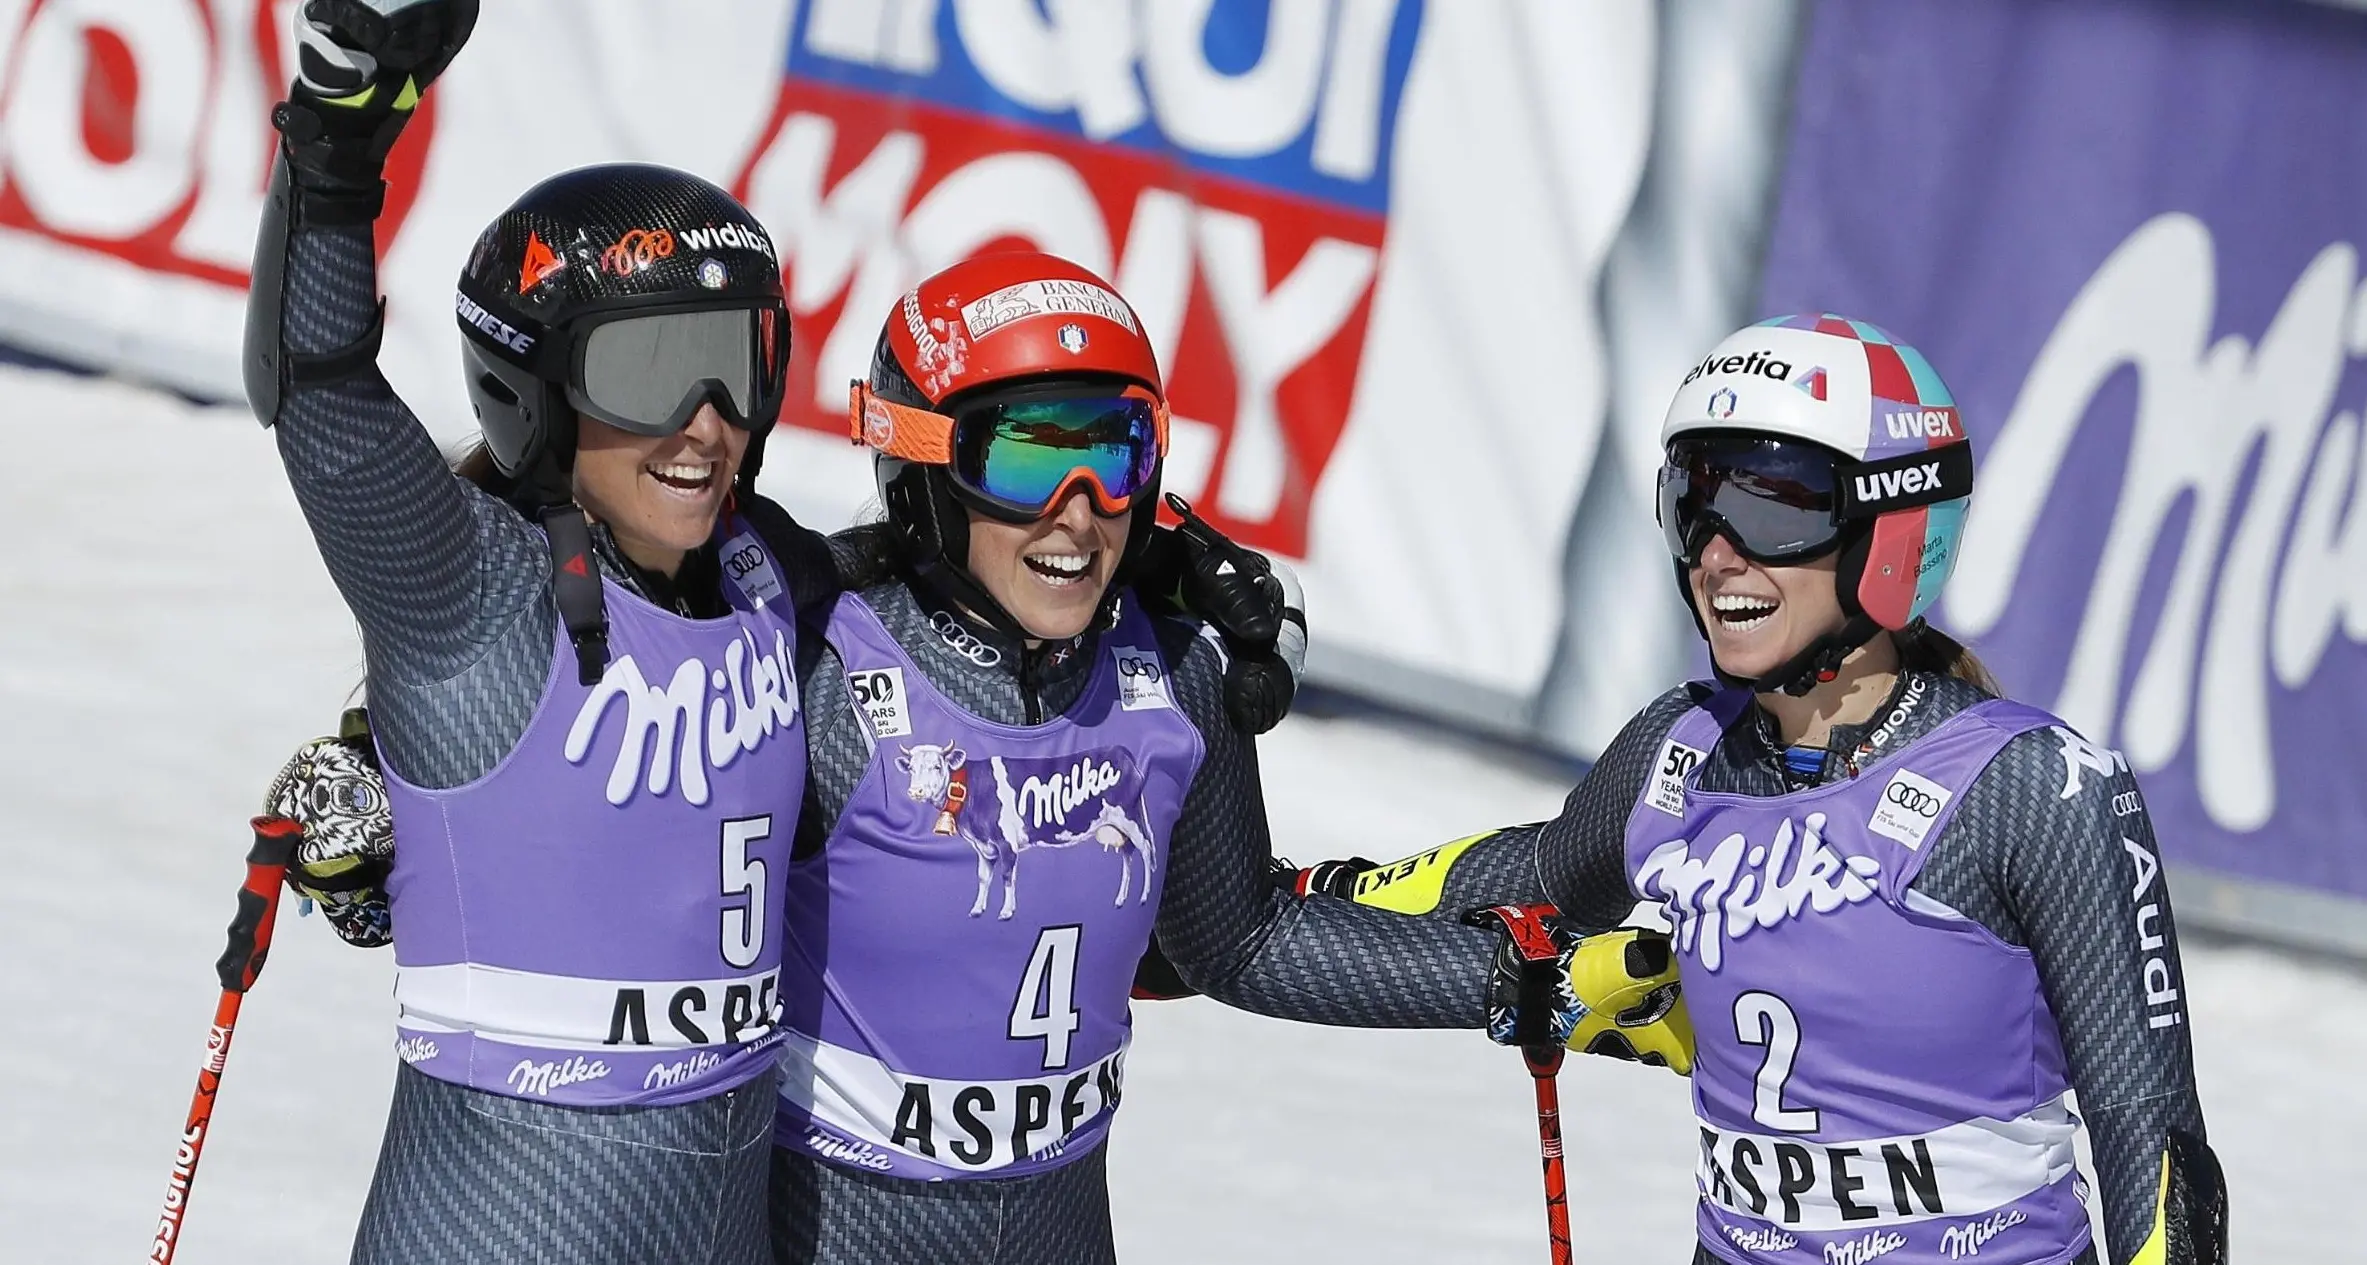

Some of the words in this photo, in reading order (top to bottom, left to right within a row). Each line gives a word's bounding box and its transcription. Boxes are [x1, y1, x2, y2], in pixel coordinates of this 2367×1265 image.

[1040, 281, 1110, 304] BANCA
[456, 290, 536, 354] AINESE
[1681, 350, 1792, 387] elvetia
[1885, 410, 1954, 440] uvex
[1854, 460, 1942, 502] uvex
[850, 671, 894, 706] 50
[865, 706, 897, 720] ARS
[1663, 744, 1698, 779] 50
[1018, 756, 1121, 829] Milka
[719, 812, 774, 970] 5
[1357, 848, 1442, 897] LEKI
[2123, 836, 2181, 1029] Audi
[1005, 922, 1084, 1071] 4
[507, 1055, 612, 1096] Milka
[1732, 988, 1821, 1134] 2
[147, 1126, 202, 1265] SSIGNOL
[1698, 1125, 1945, 1224] ASPEN
[1823, 1229, 1909, 1265] Milka
[1939, 1209, 2028, 1260] Milka
